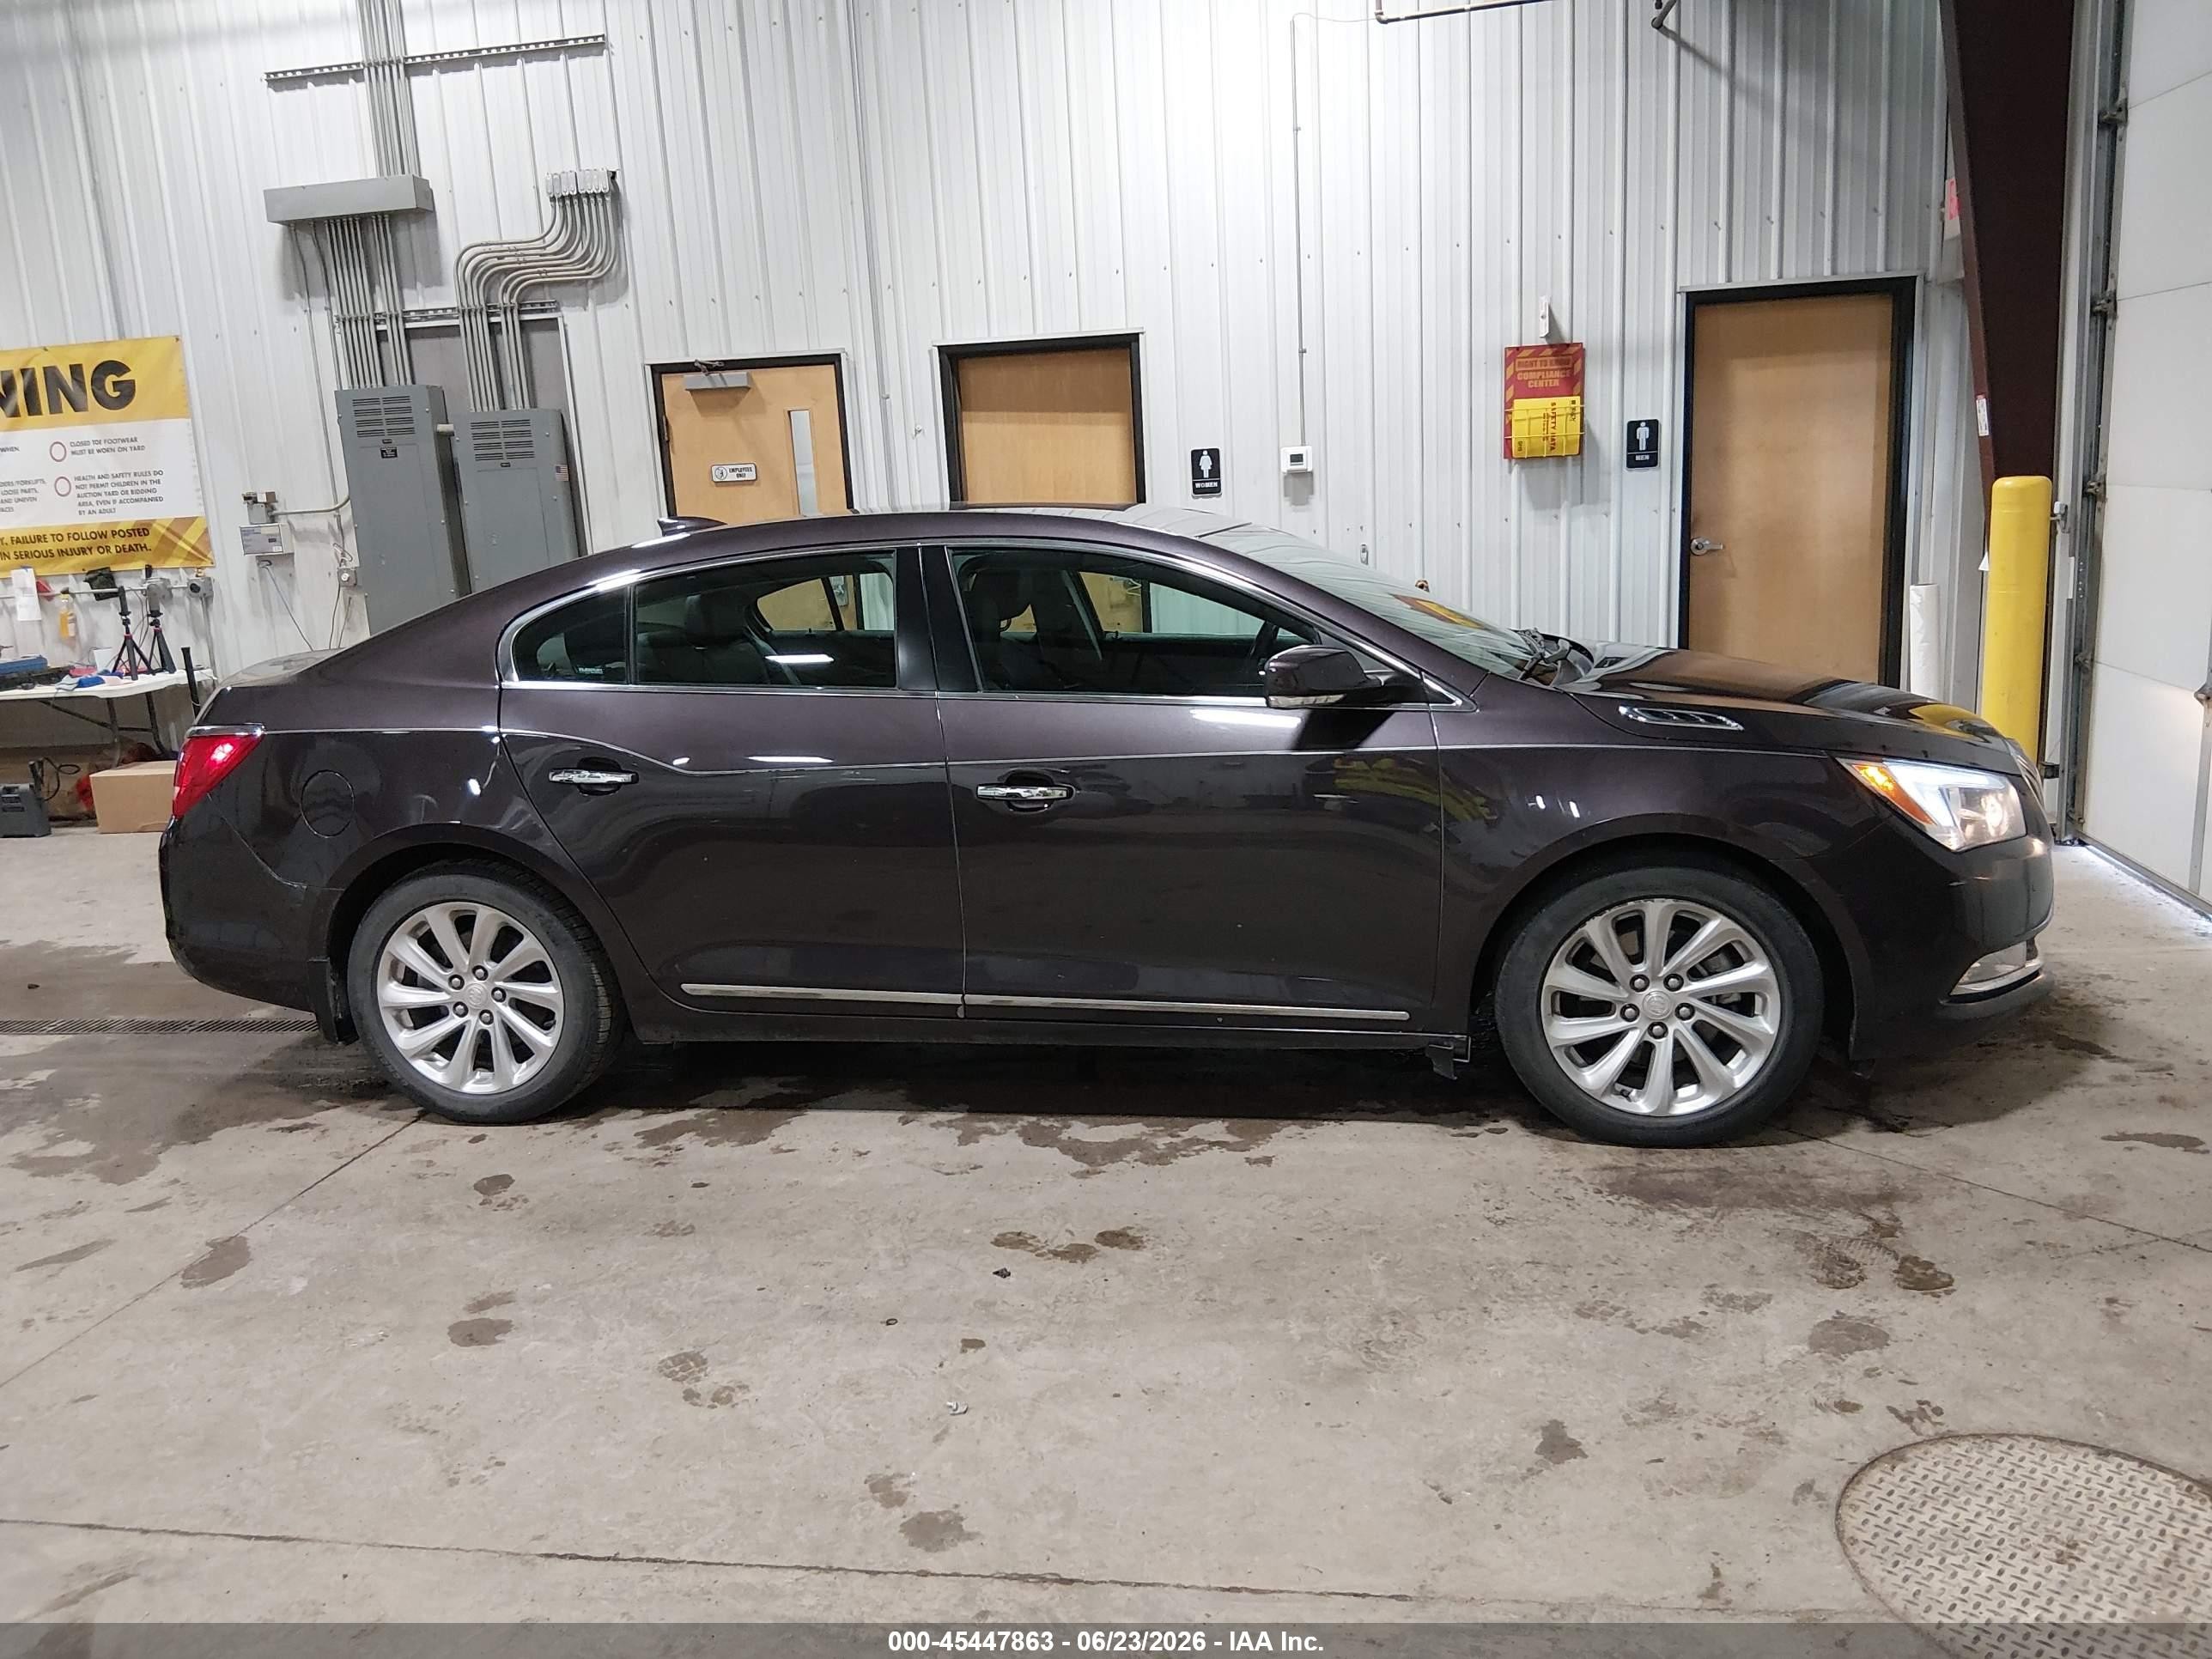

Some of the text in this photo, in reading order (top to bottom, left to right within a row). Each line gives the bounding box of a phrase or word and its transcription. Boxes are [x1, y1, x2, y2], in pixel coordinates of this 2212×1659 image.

[1516, 368, 1571, 380] COMPLIANCE
[1528, 378, 1559, 388] CENTER
[104, 436, 138, 445] FOOTWEAR
[118, 495, 163, 505] ACCOMPANIED
[10, 534, 48, 545] FAILURE
[51, 532, 64, 543] TO
[68, 530, 107, 542] FOLLOW
[112, 527, 150, 539] POSTED
[0, 543, 152, 561] IN SERIOUS INJURY OR DEATH.
